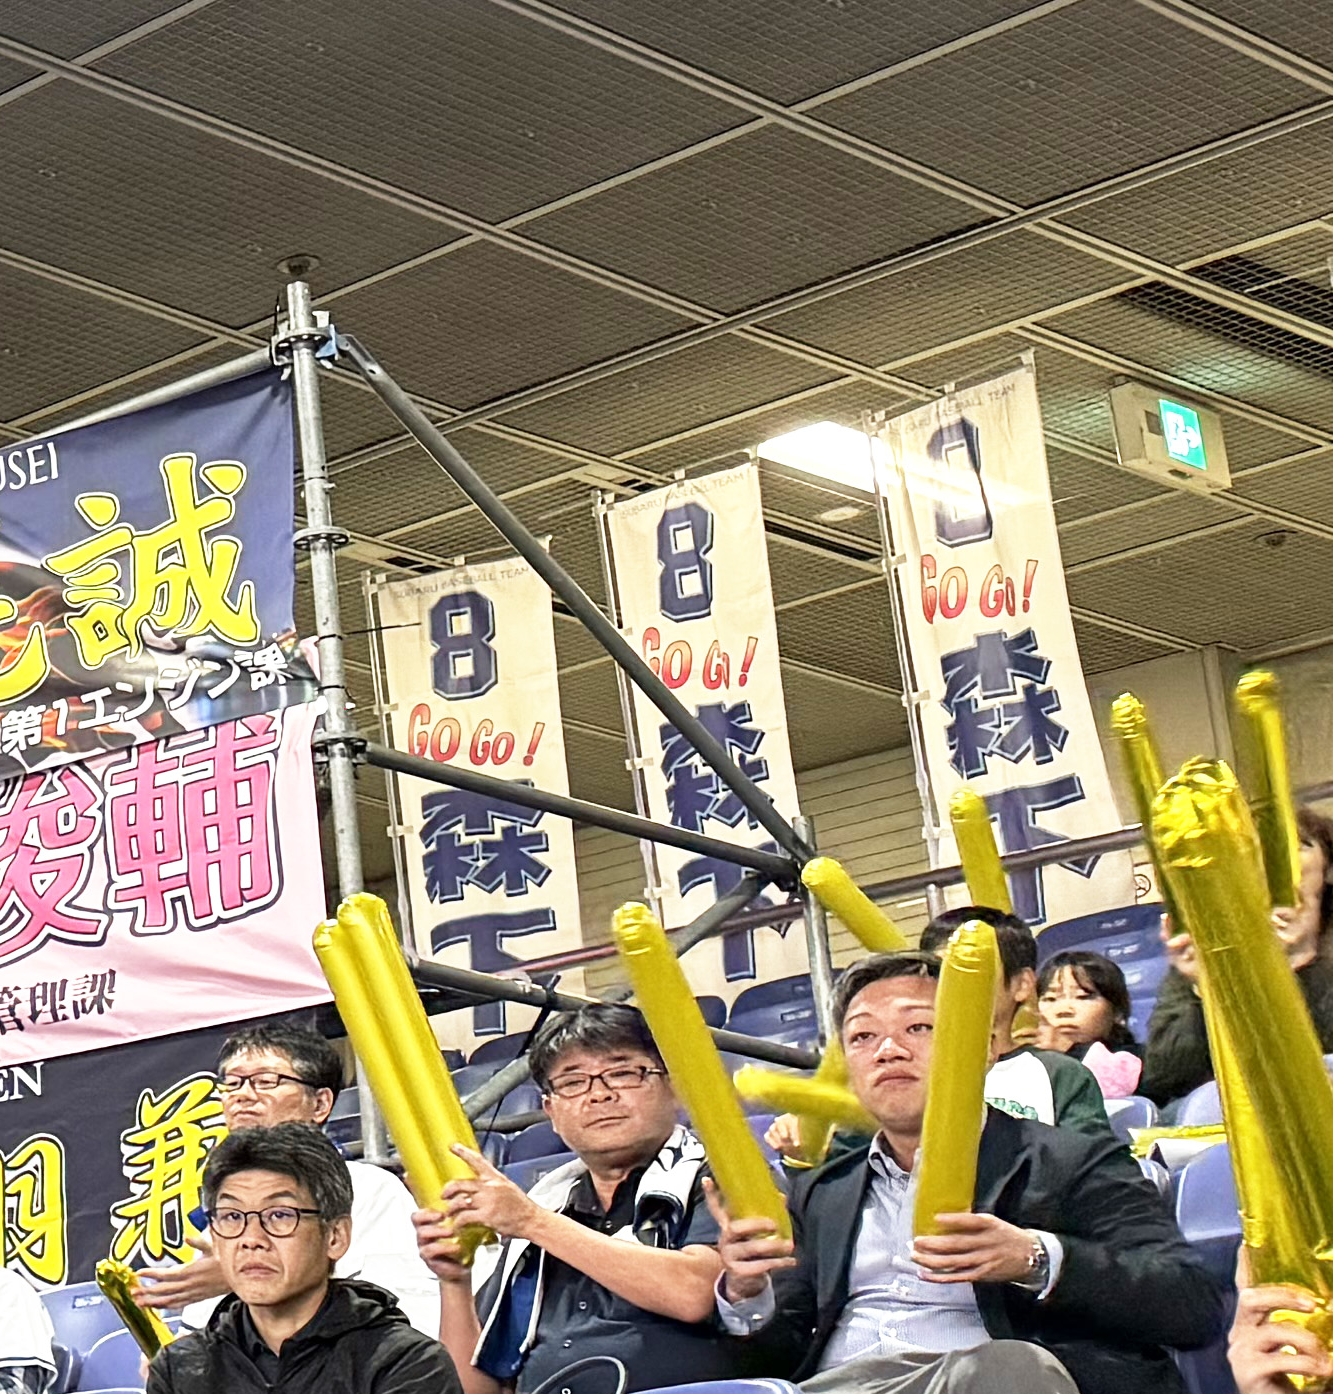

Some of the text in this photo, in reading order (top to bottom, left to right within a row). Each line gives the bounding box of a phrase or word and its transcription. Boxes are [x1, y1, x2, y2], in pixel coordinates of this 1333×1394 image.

[658, 501, 714, 623] 8
[0, 645, 290, 754] 第1エンジン課
[429, 589, 498, 701] 8
